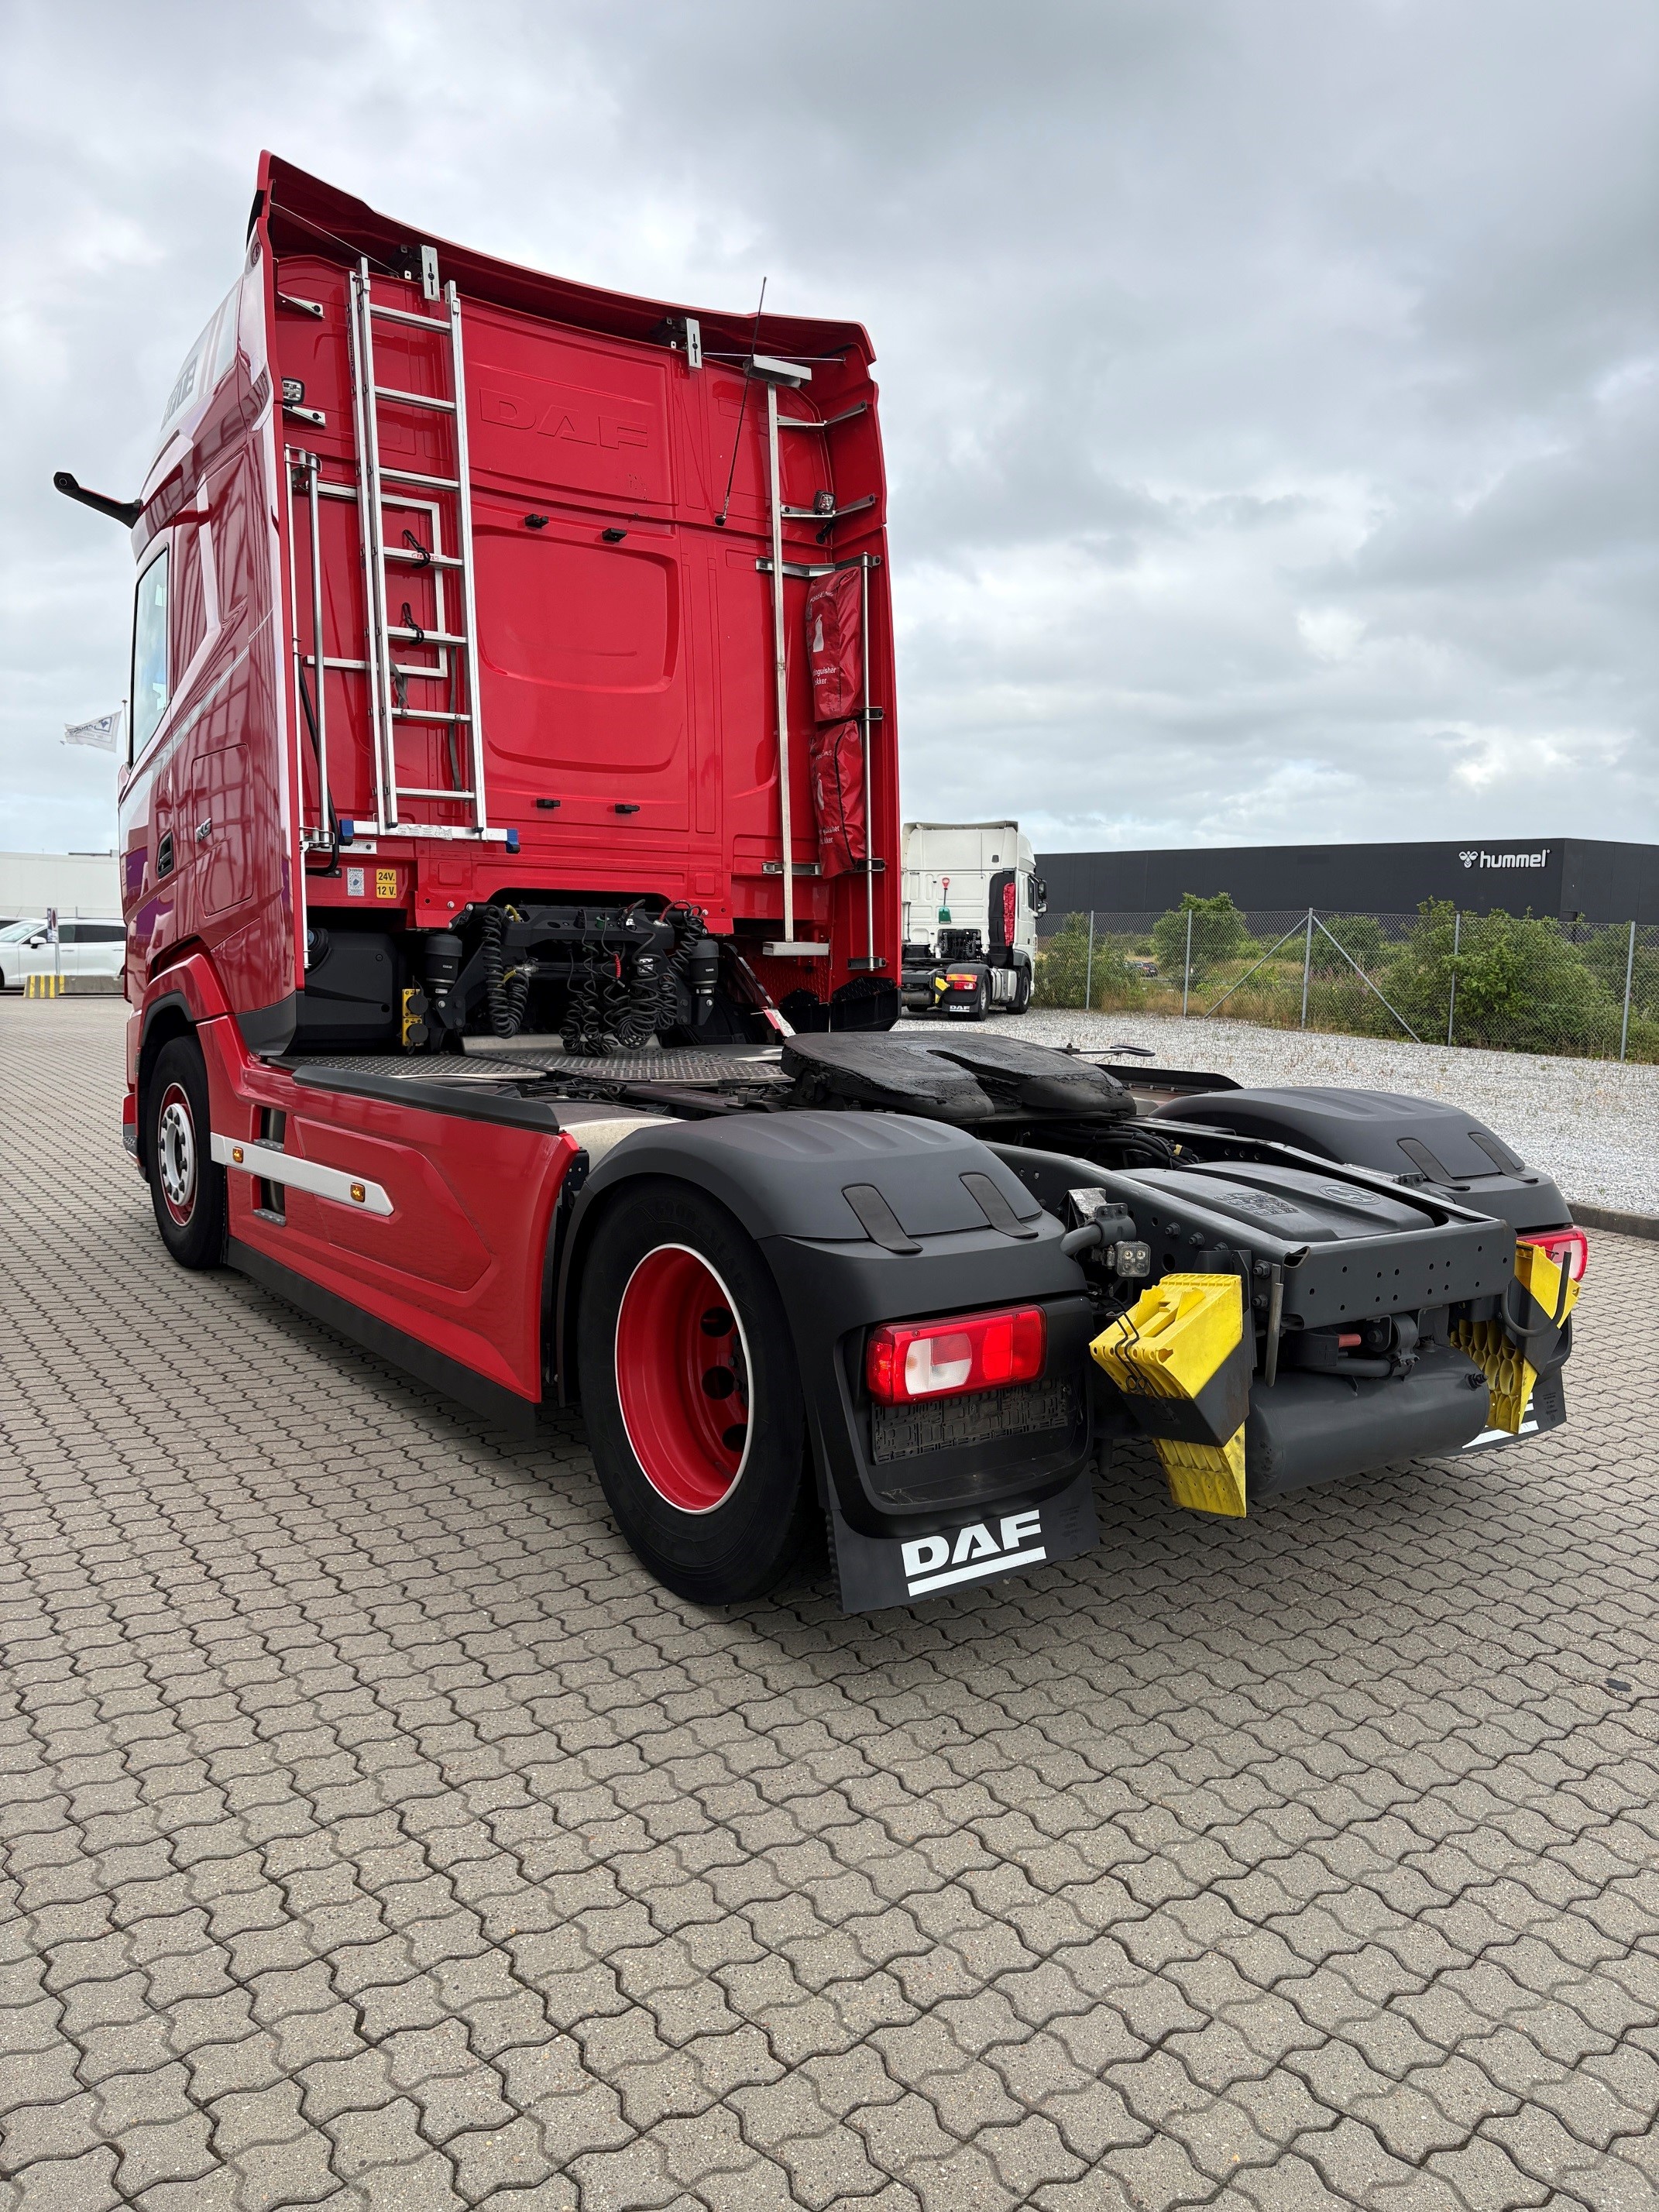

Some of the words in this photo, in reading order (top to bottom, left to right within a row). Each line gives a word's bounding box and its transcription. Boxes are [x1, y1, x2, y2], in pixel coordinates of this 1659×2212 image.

[479, 387, 648, 449] DAF
[1479, 849, 1547, 868] hummel
[378, 871, 395, 881] 24V.
[377, 886, 386, 895] 12
[389, 886, 397, 895] V.
[901, 1509, 1042, 1577] DAF
